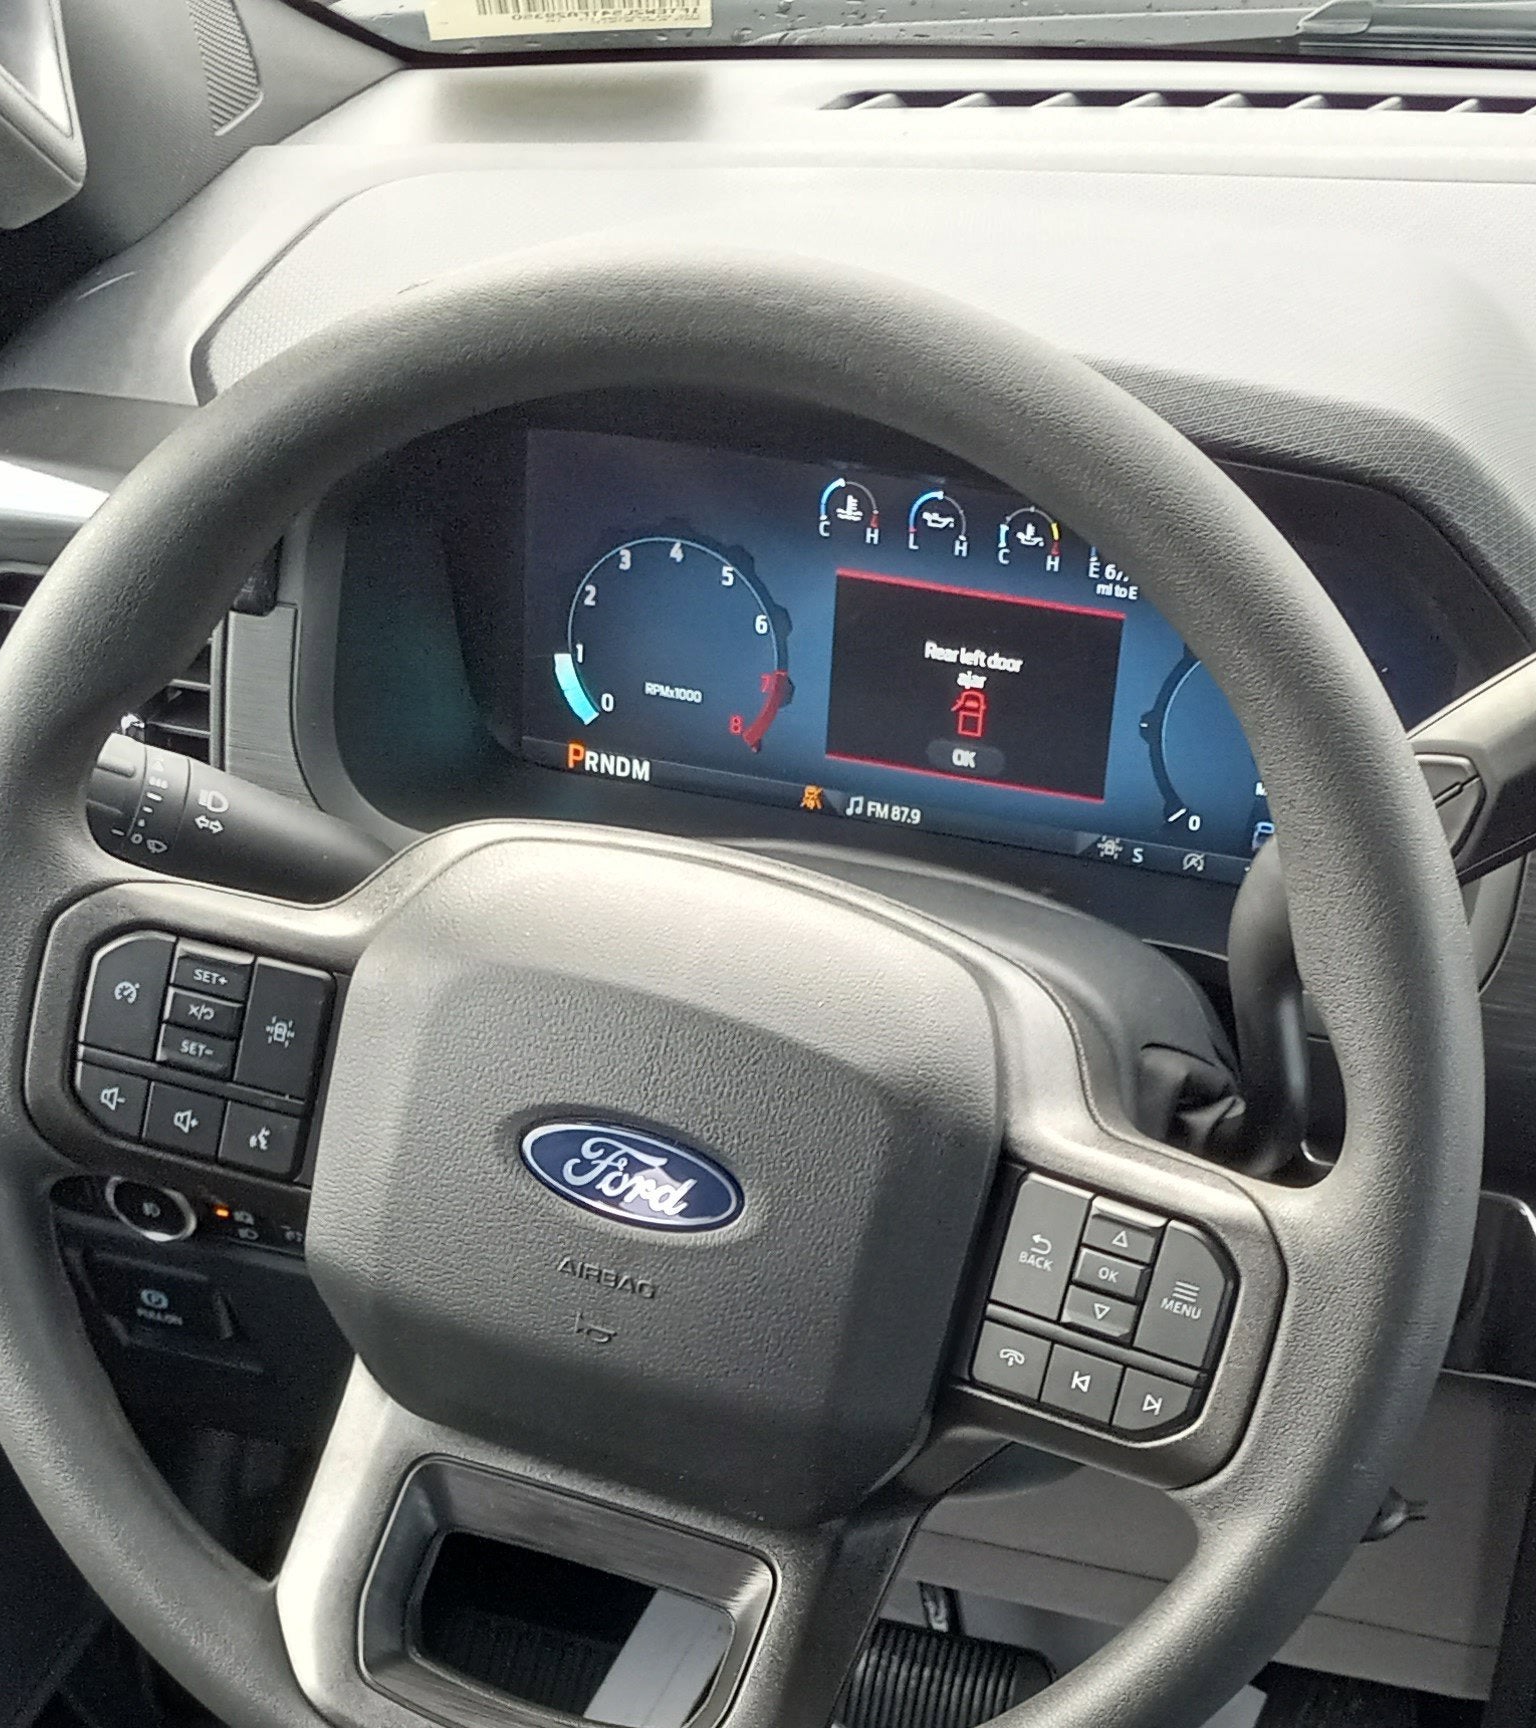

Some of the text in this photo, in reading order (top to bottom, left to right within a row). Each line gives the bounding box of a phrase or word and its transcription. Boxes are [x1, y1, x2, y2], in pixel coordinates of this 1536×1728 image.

[817, 519, 830, 537] C
[865, 528, 880, 544] H
[669, 541, 684, 562] 4
[954, 540, 968, 556] H
[998, 549, 1010, 565] C
[618, 549, 631, 570] 3
[1046, 555, 1060, 572] H
[721, 565, 734, 586] 5
[583, 585, 597, 606] 2
[754, 614, 768, 634] 6
[575, 642, 584, 663] 1
[924, 640, 1024, 673] Rear left door
[956, 670, 988, 690] ajar
[600, 693, 614, 712] 0
[729, 714, 744, 734] 8
[951, 747, 977, 768] OK
[866, 800, 922, 825] FM 87.9
[1188, 815, 1201, 832] 0
[192, 968, 229, 986] SET+
[562, 1136, 698, 1216] Ford
[1017, 1250, 1054, 1273] BACK
[555, 1255, 658, 1300] AIRBAG
[1097, 1265, 1120, 1284] OK
[1159, 1297, 1202, 1320] MENU
